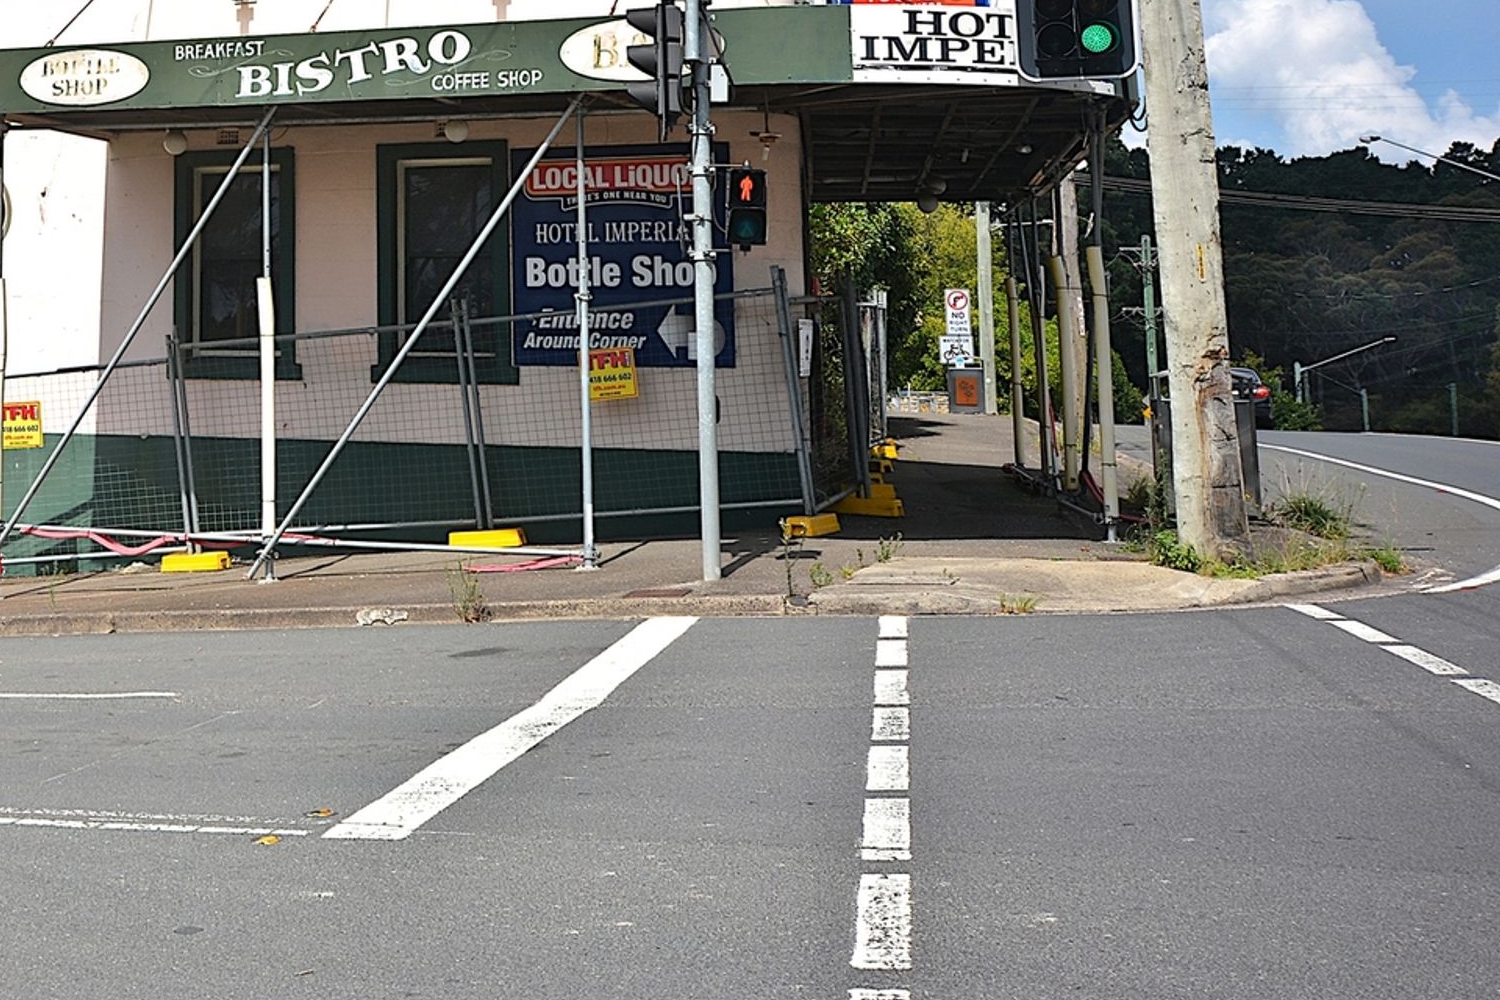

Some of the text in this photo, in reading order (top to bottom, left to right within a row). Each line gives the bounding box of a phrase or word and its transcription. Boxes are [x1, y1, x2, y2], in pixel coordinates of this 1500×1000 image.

[174, 41, 265, 61] BREAKFAST
[860, 35, 1015, 66] IMPE
[235, 31, 472, 99] BISTRO
[52, 78, 108, 96] SHOP
[430, 70, 544, 91] COFFEE SHOP
[533, 162, 694, 190] LOCAL LiQUO
[603, 190, 621, 199] ONE
[623, 191, 647, 199] NEAR
[650, 193, 668, 203] YOU
[605, 221, 695, 243] IMPERIA
[632, 255, 716, 287] Sho
[589, 332, 647, 350] Corner
[2, 405, 36, 421] TFH
